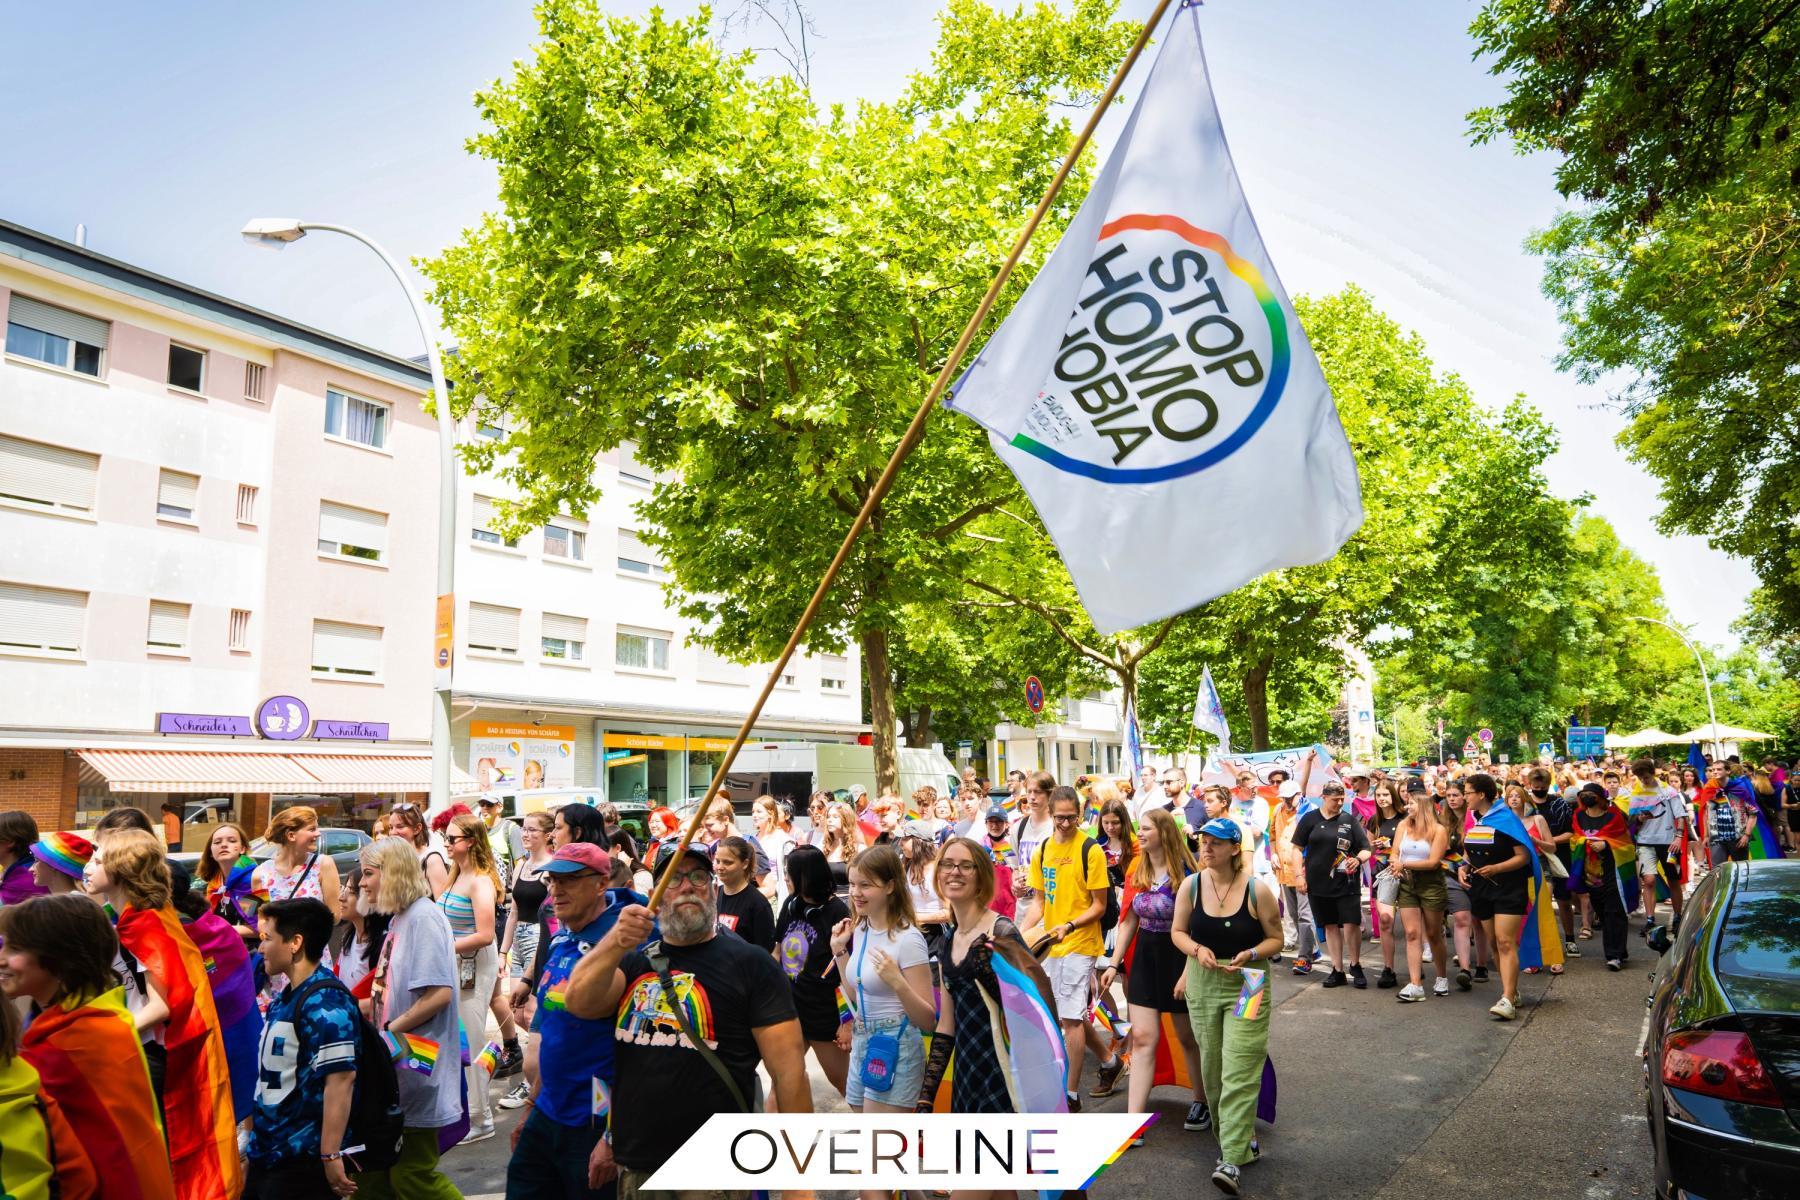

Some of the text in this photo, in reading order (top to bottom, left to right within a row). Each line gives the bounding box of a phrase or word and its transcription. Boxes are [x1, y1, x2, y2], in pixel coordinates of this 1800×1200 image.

[1148, 249, 1264, 387] STOP
[1079, 243, 1219, 442] HOMO
[1054, 328, 1153, 465] OBIA
[173, 717, 237, 733] Schneider's
[328, 722, 379, 738] Schnittchen
[505, 728, 527, 736] HEIZUNG
[539, 729, 560, 737] SCHÄFER
[475, 742, 507, 753] SCHÄFER
[528, 743, 558, 754] SCHÄFER
[626, 738, 647, 746] Schöne
